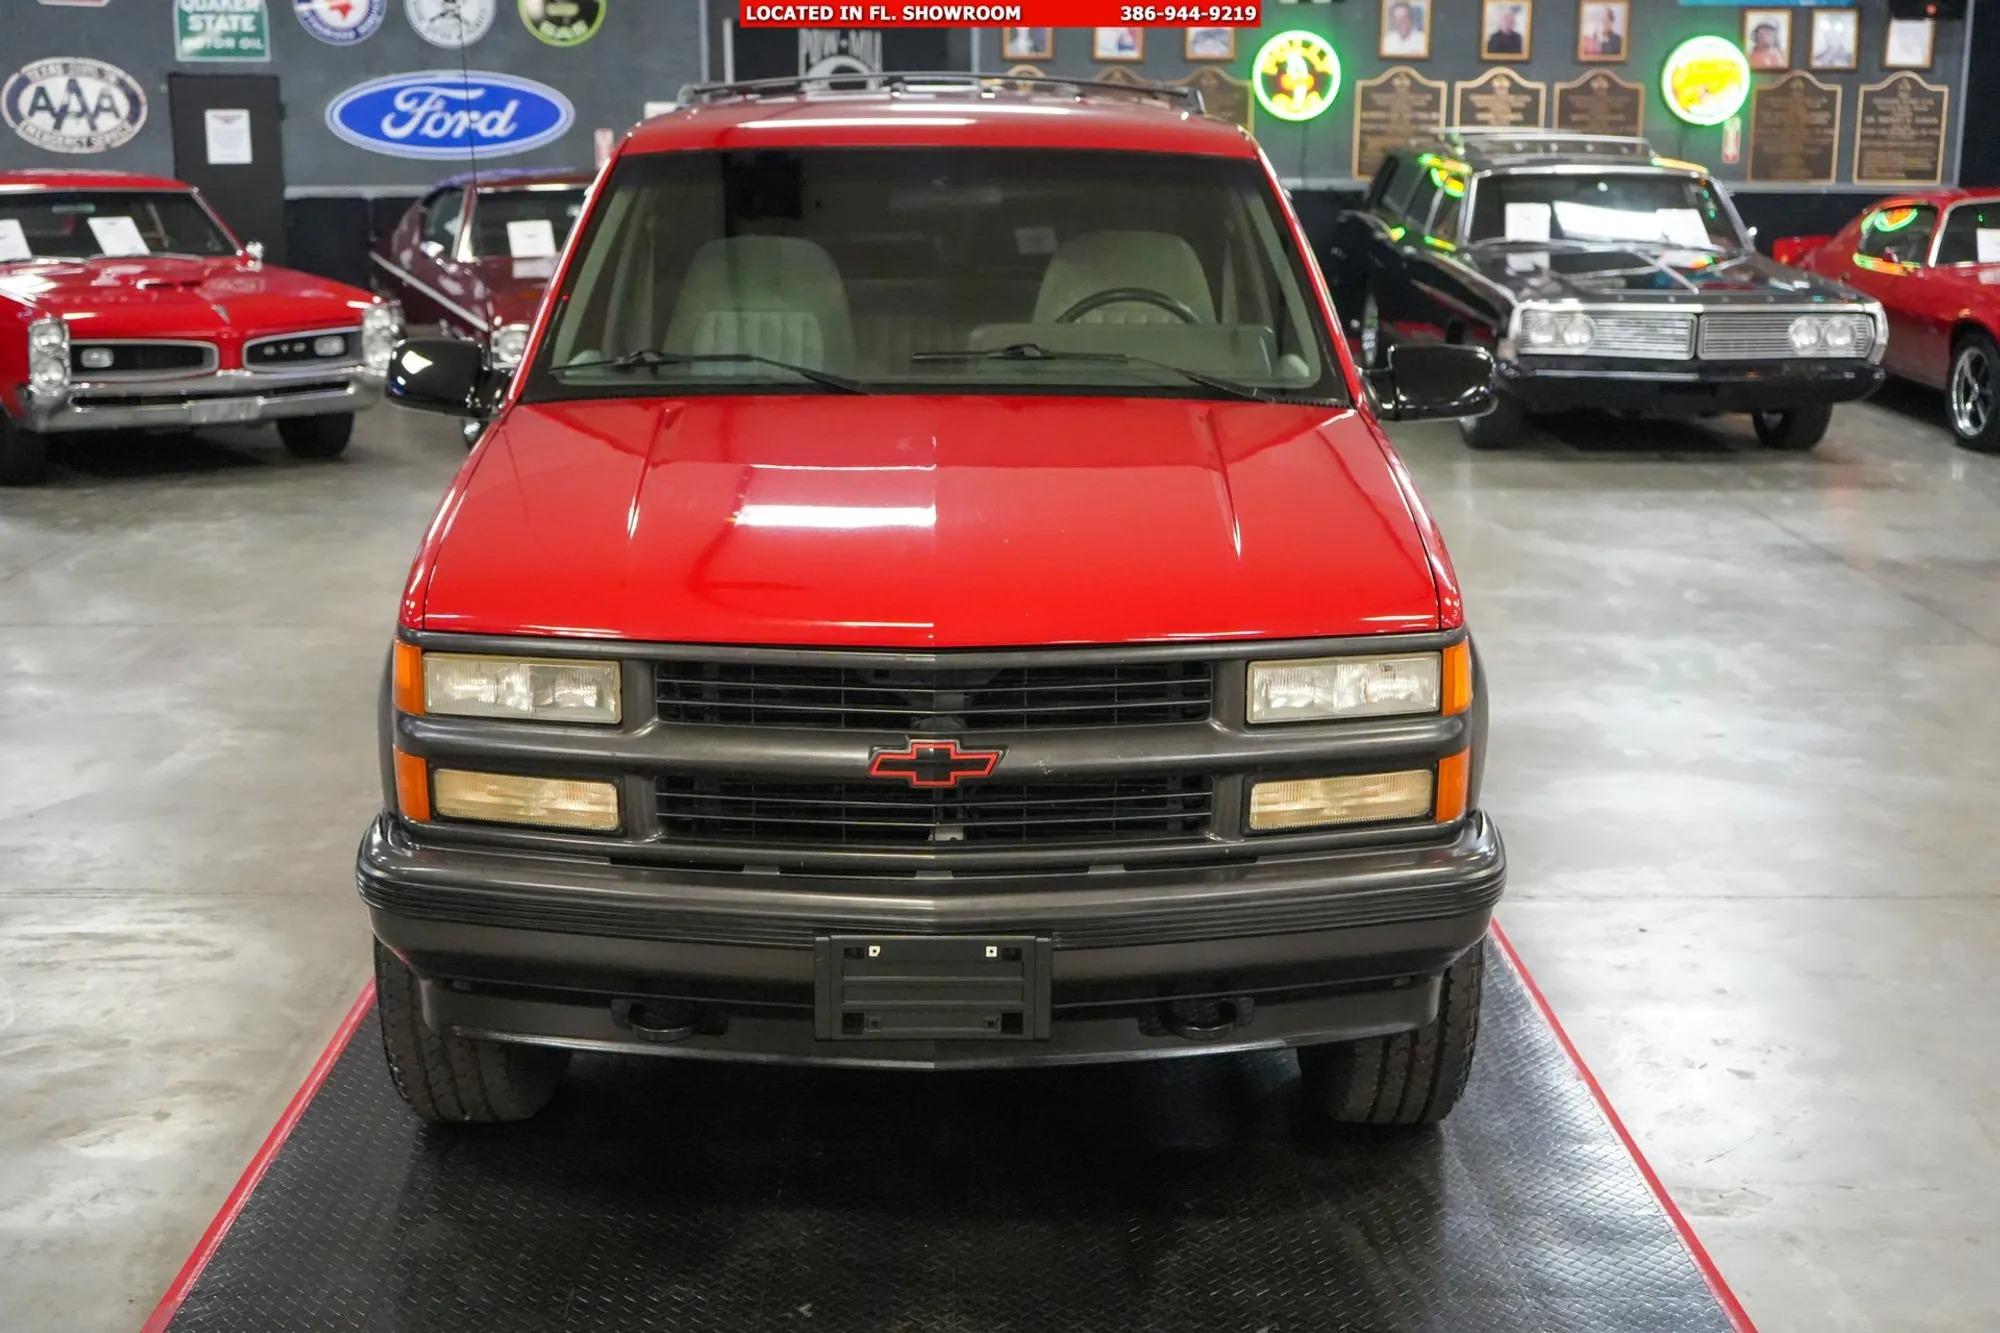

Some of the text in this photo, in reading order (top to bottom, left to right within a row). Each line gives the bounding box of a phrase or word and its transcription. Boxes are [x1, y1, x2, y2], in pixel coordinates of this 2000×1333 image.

[187, 13, 256, 32] STATE
[28, 79, 121, 131] AAA
[380, 86, 521, 139] Ford
